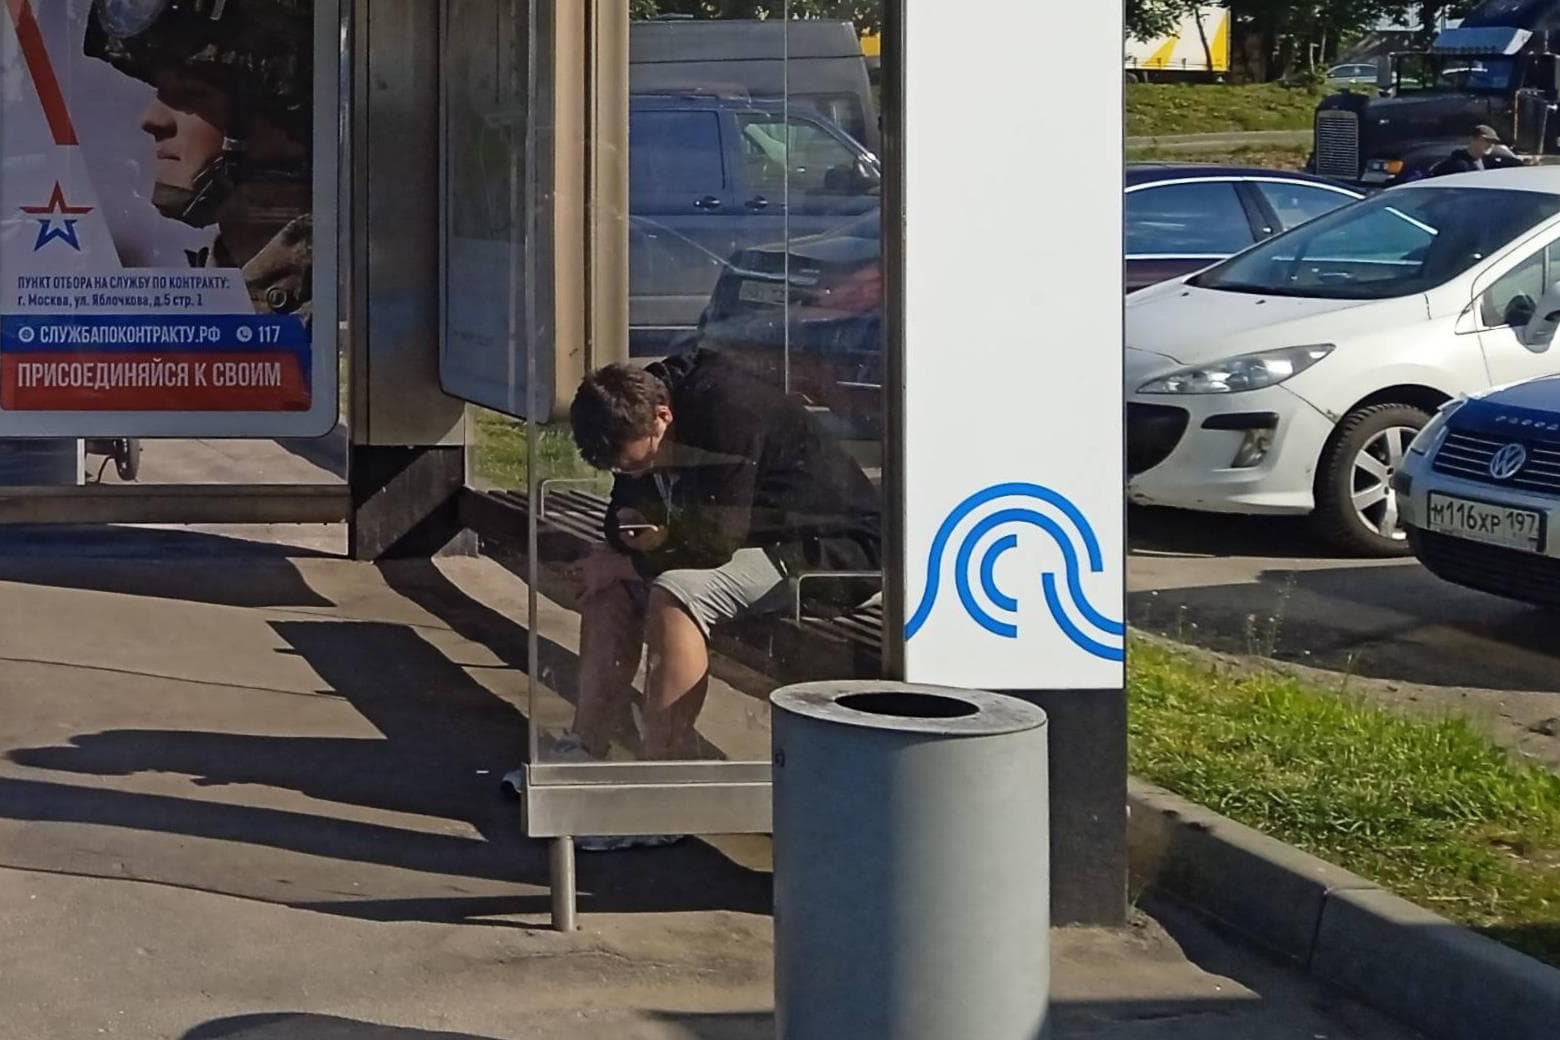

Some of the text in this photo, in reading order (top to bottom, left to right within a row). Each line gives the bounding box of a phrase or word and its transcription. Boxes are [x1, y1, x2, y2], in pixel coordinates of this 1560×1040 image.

[18, 276, 231, 289] ПУНКТ ОТБОРА НА СЛУЖБУ ПО КОНТРАКТУ:
[18, 295, 26, 306] г.
[28, 294, 73, 308] Москва,
[73, 295, 90, 308] ул.
[92, 293, 152, 308] Яблочкова,
[173, 295, 195, 308] стр.
[197, 293, 203, 306] 1
[40, 325, 281, 344] СЛУЖБАПОКОНТРАКТУ.РФ 117
[18, 358, 282, 389] ПРИСОЕДИНЯЙСЯ К СВОИМ
[1506, 511, 1536, 532] 197
